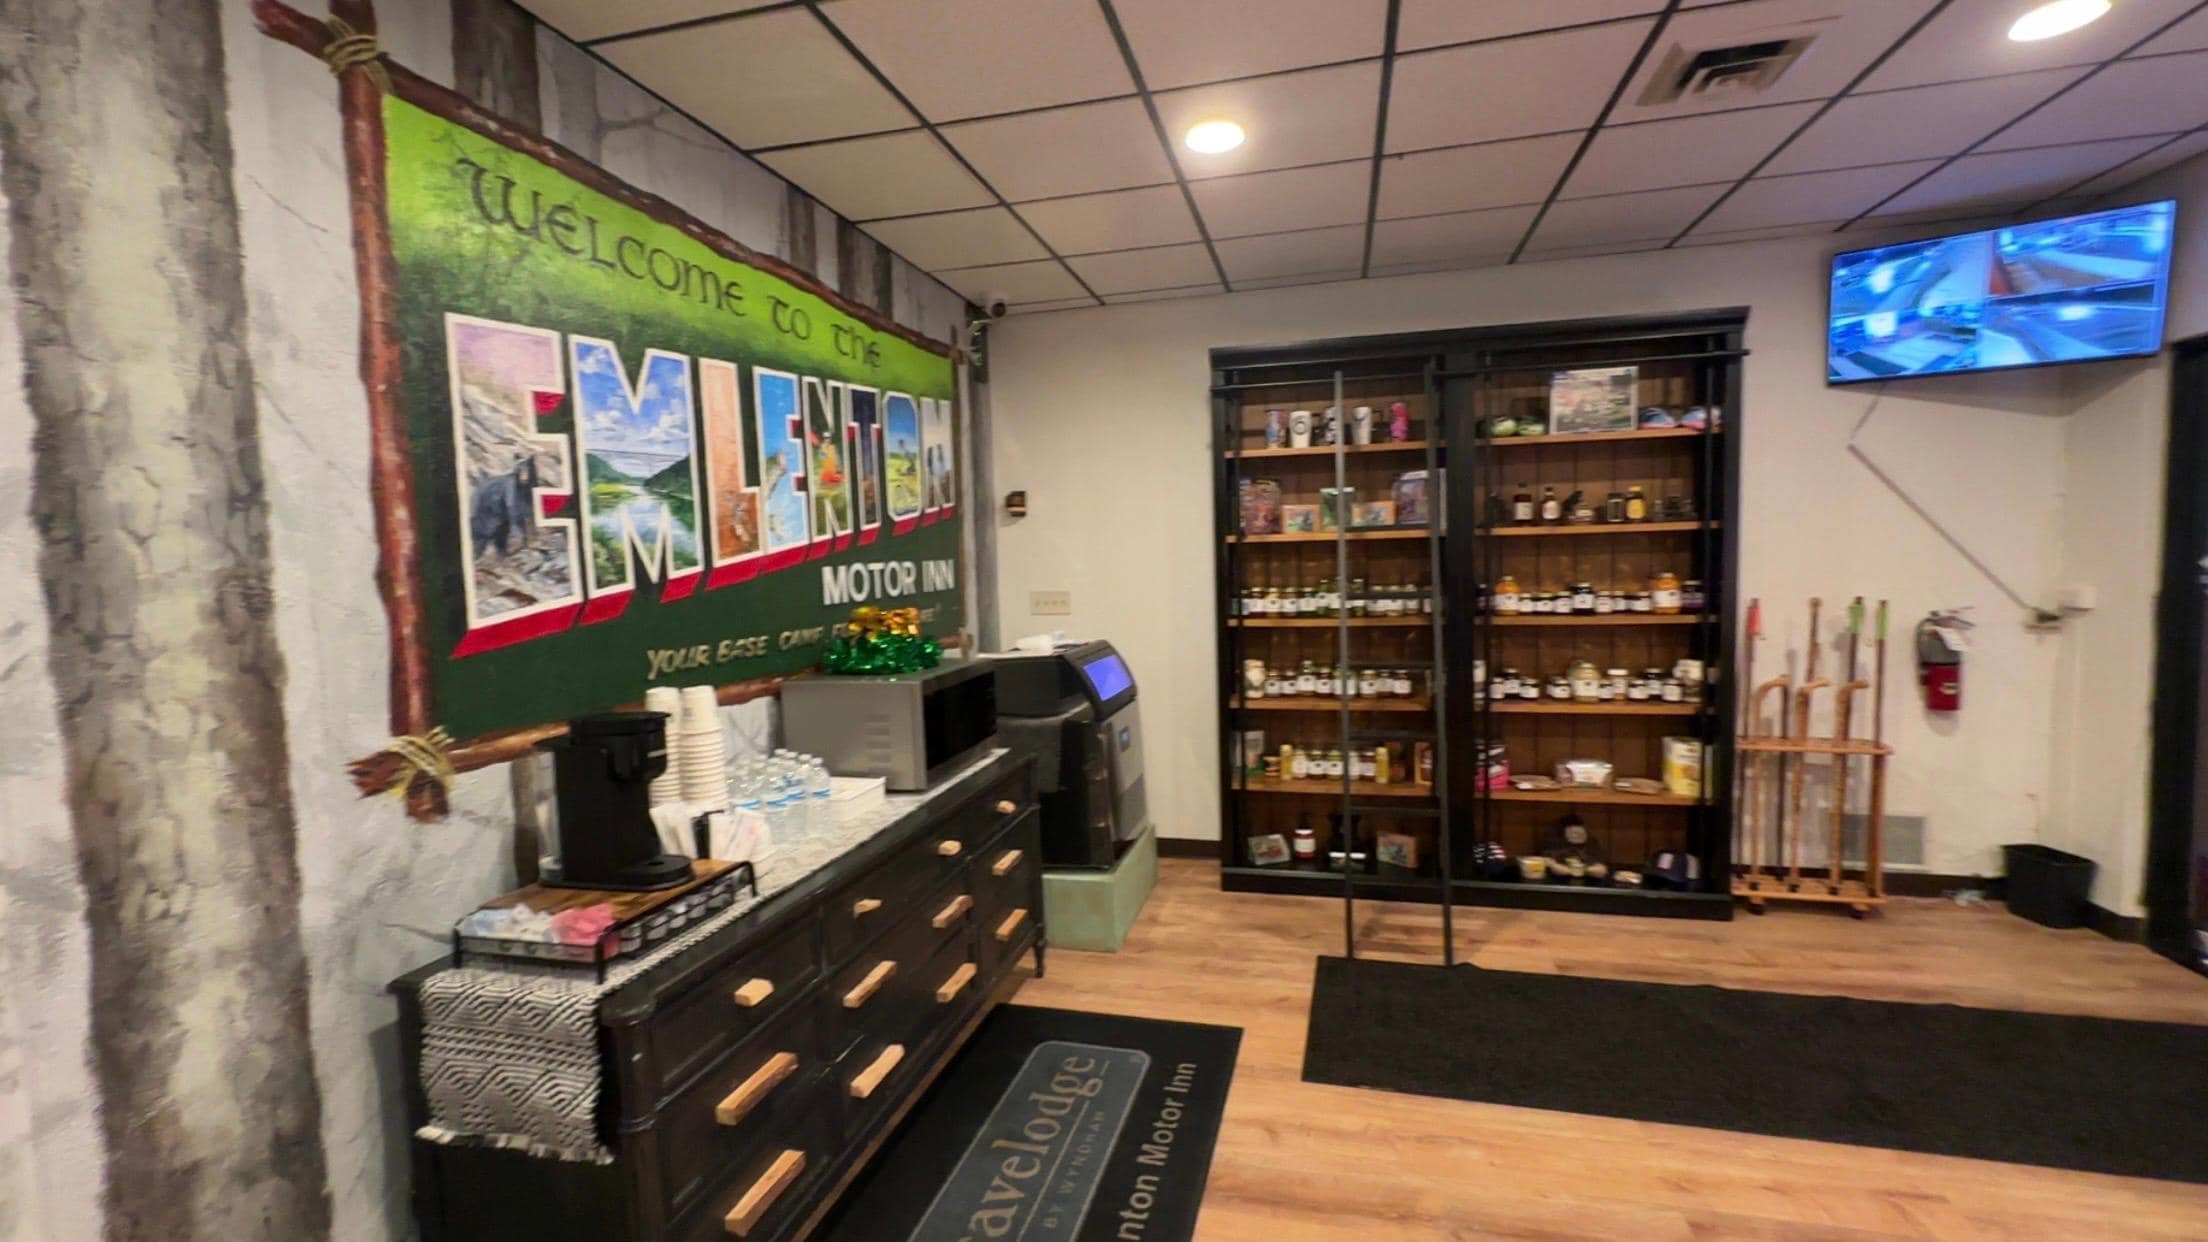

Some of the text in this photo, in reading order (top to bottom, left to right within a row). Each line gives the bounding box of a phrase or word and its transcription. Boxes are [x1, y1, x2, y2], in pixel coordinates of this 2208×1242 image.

[445, 312, 956, 634] EMLENTON
[821, 559, 956, 606] MOTOR INN
[646, 644, 712, 681] YOUR
[716, 634, 769, 664] BASE
[778, 625, 824, 651] CAMP
[1137, 1096, 1185, 1167] Motor
[1163, 1061, 1198, 1094] Inn
